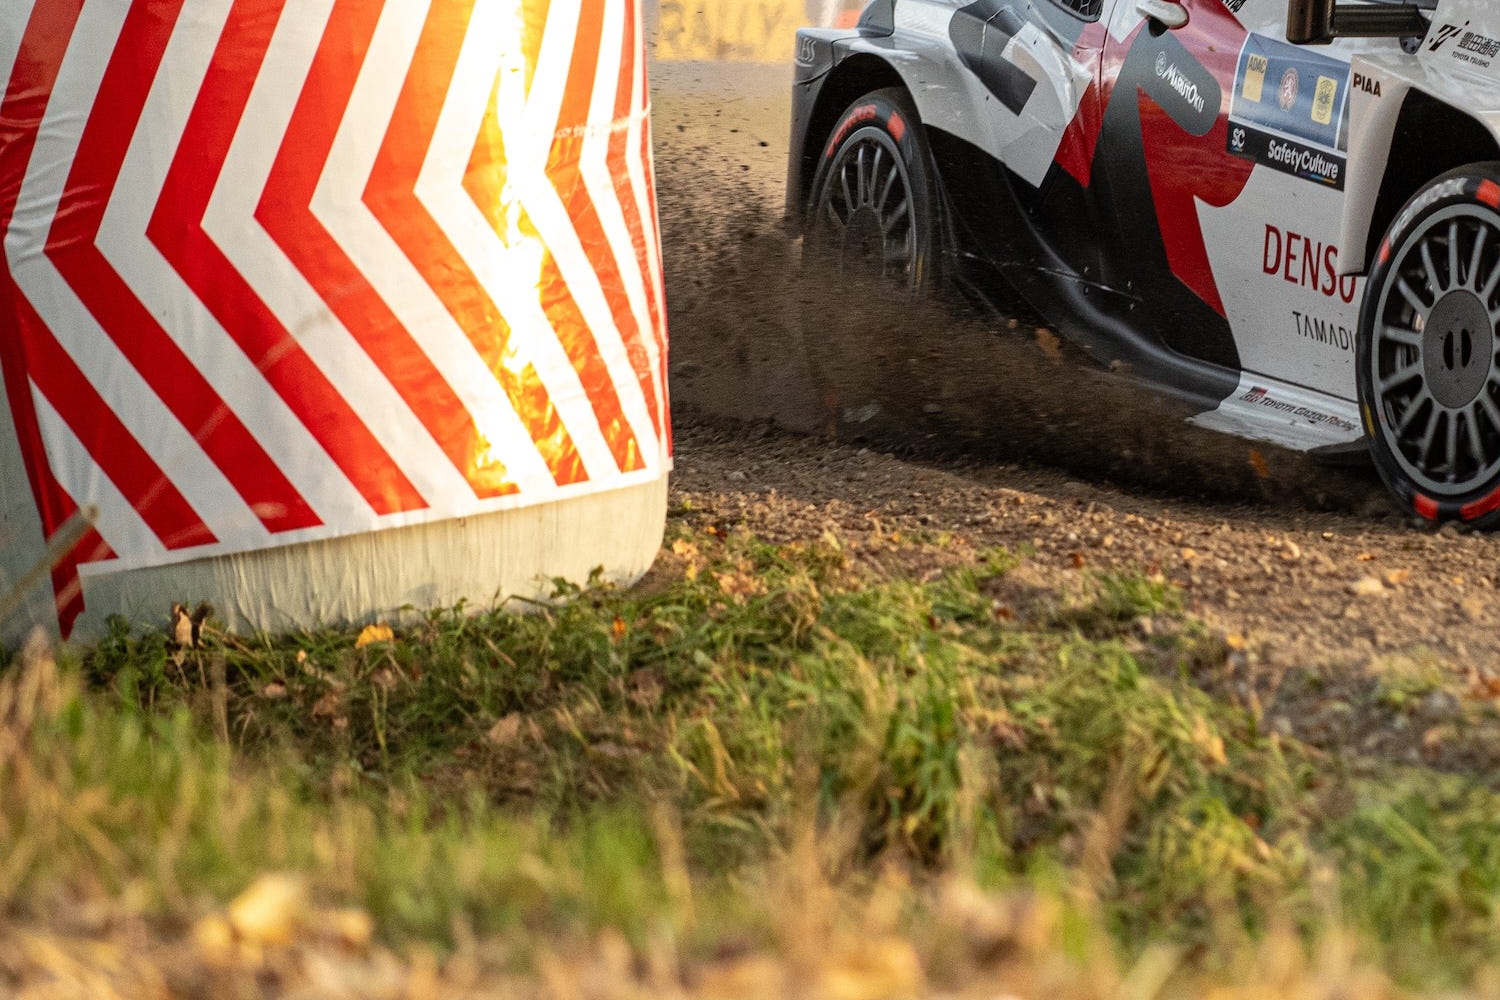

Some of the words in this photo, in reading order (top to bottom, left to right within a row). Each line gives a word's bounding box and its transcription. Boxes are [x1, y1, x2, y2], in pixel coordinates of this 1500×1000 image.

[1248, 56, 1267, 74] ADAC
[1352, 72, 1382, 98] PIAA
[1231, 127, 1246, 149] SC
[1267, 139, 1339, 179] SafetyCulture
[1292, 310, 1355, 353] TAMADI
[1260, 397, 1296, 413] TOYOTA
